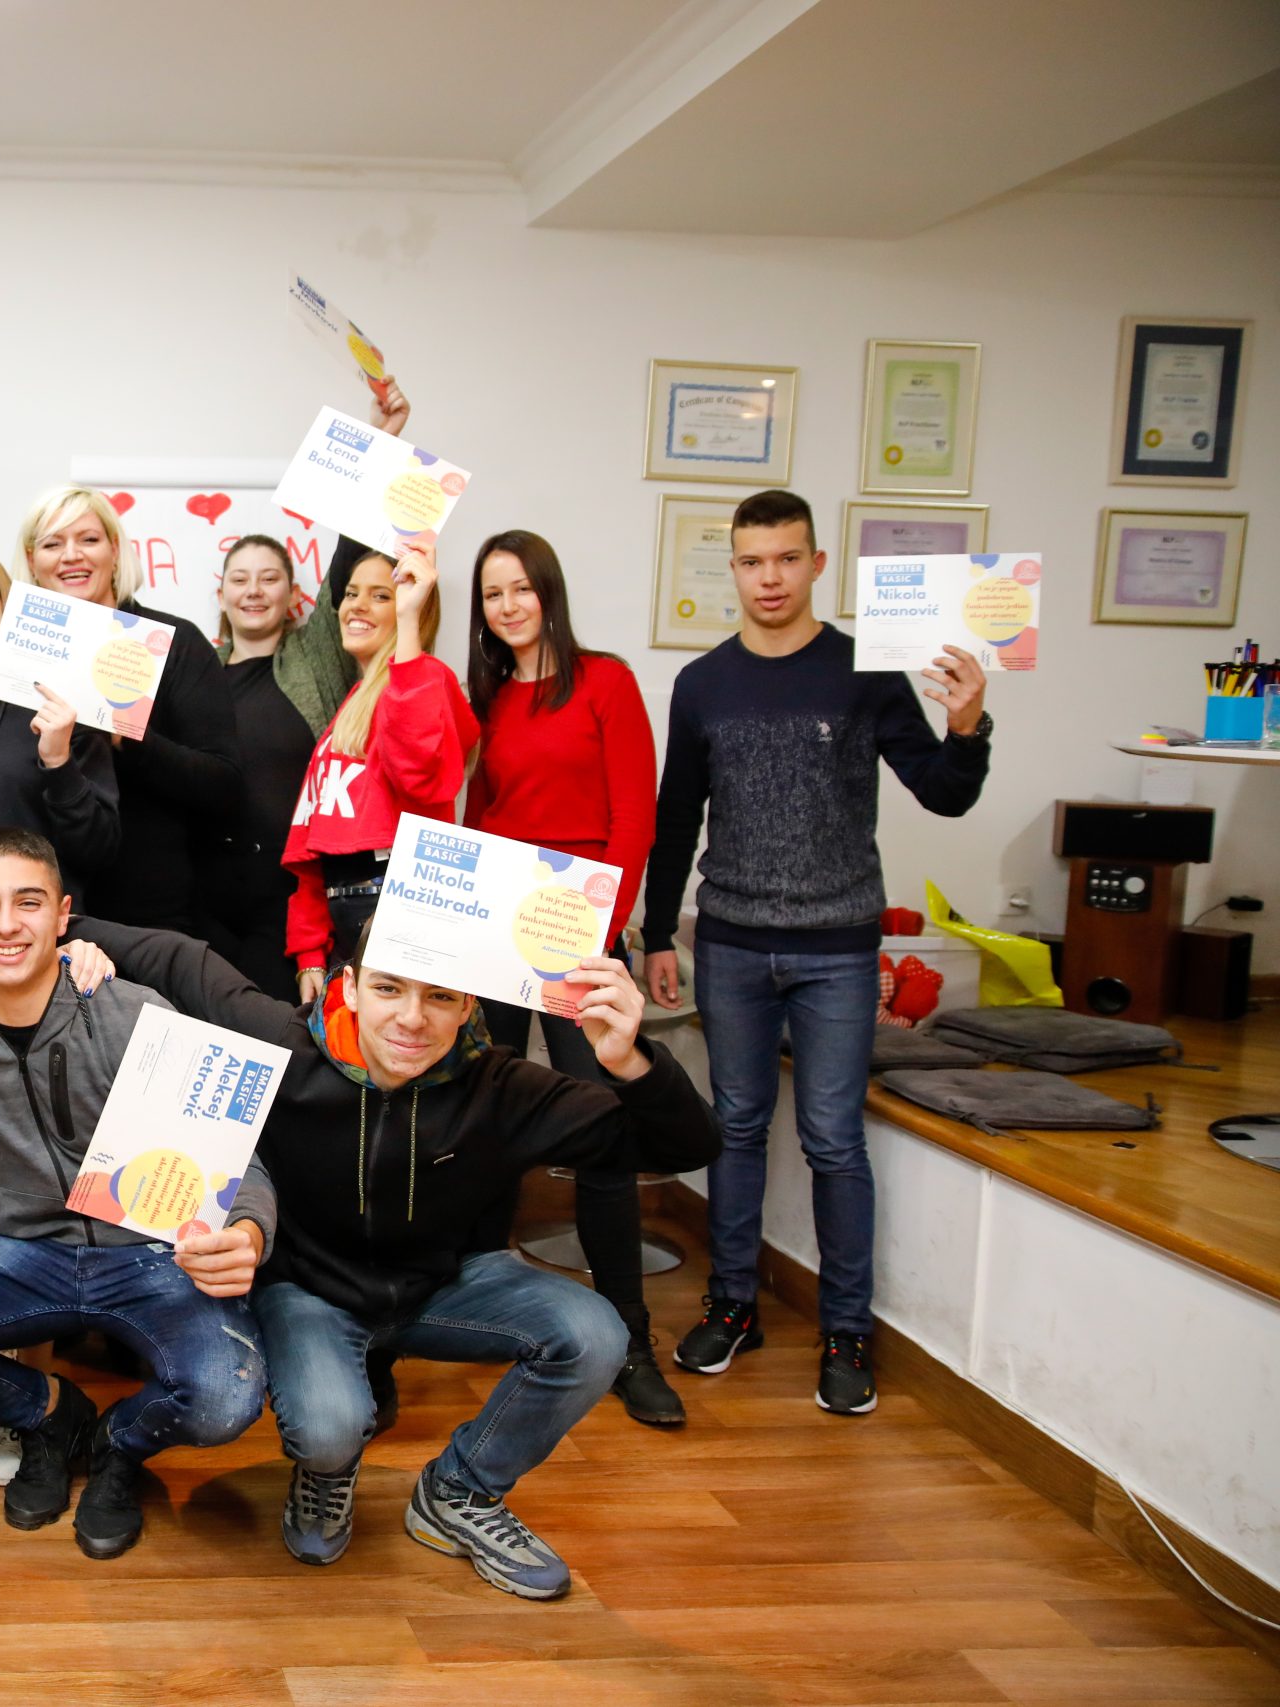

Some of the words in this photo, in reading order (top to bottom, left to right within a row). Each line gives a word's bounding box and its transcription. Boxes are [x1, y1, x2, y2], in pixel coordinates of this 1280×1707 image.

[326, 440, 360, 463] Lena
[308, 450, 365, 482] Babović
[26, 594, 69, 614] SMARTER
[877, 587, 926, 600] Nikola
[28, 606, 56, 620] BASIC
[863, 603, 939, 617] Jovanović
[16, 615, 72, 644] Teodora
[6, 631, 70, 661] Pistovšek
[421, 831, 478, 855] SMARTER
[424, 847, 461, 864] BASIC
[413, 862, 475, 892] Nikola
[386, 879, 490, 920] Mažibrada
[552, 897, 562, 907] je
[563, 899, 587, 912] poput
[534, 904, 579, 922] padobrana
[520, 927, 536, 936] ako
[535, 930, 545, 939] je
[182, 1043, 224, 1119] Petrović
[201, 1054, 242, 1122] Aleksej
[235, 1069, 256, 1106] BASIC
[243, 1068, 272, 1122] SMARTER
